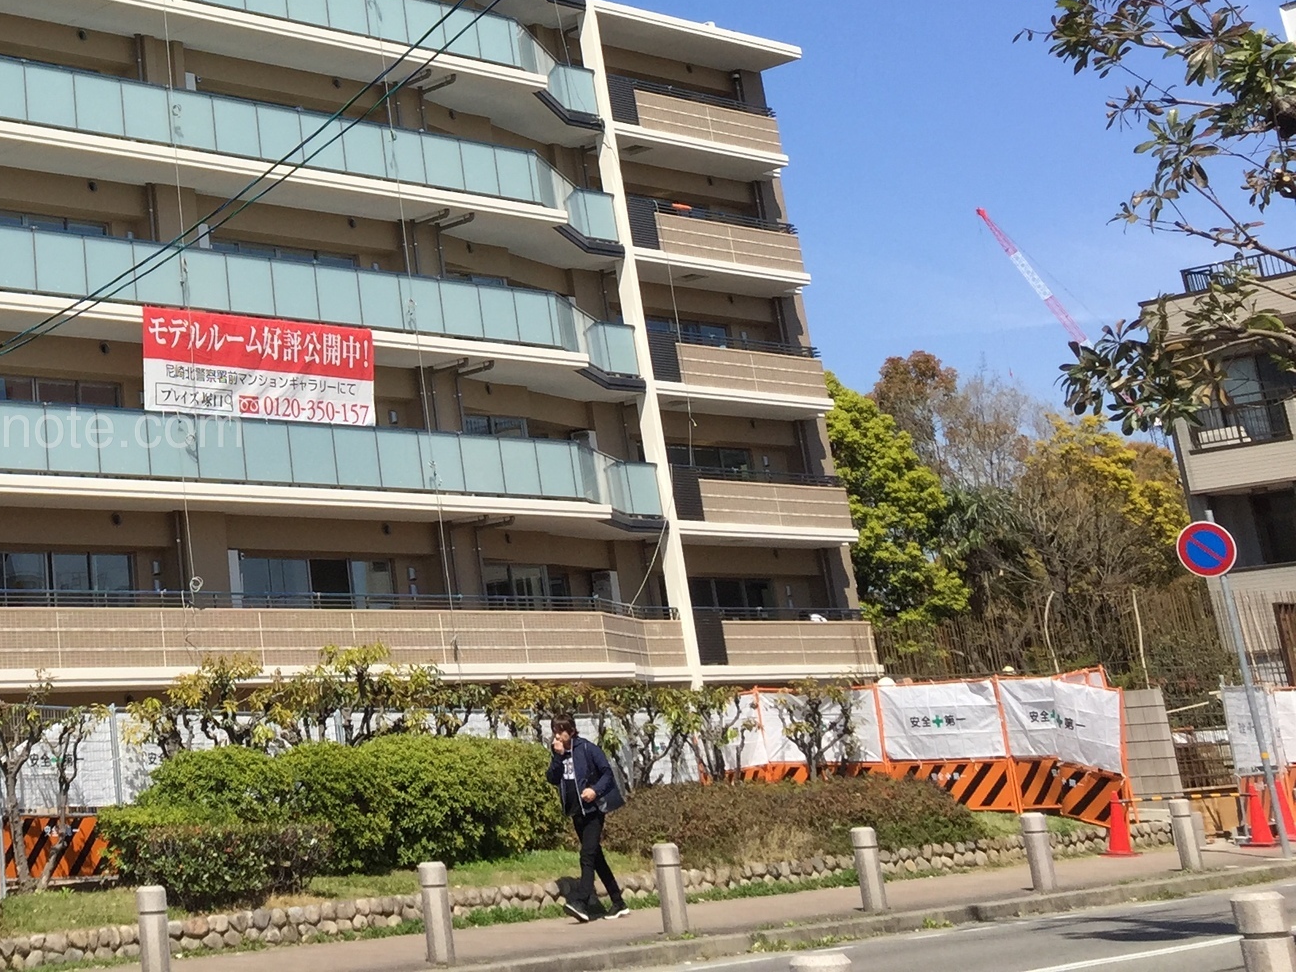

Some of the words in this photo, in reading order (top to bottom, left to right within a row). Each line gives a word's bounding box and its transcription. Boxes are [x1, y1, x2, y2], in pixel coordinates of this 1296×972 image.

[148, 317, 369, 369] モデルルーム好評公開中!
[263, 396, 370, 425] 0120-350-157
